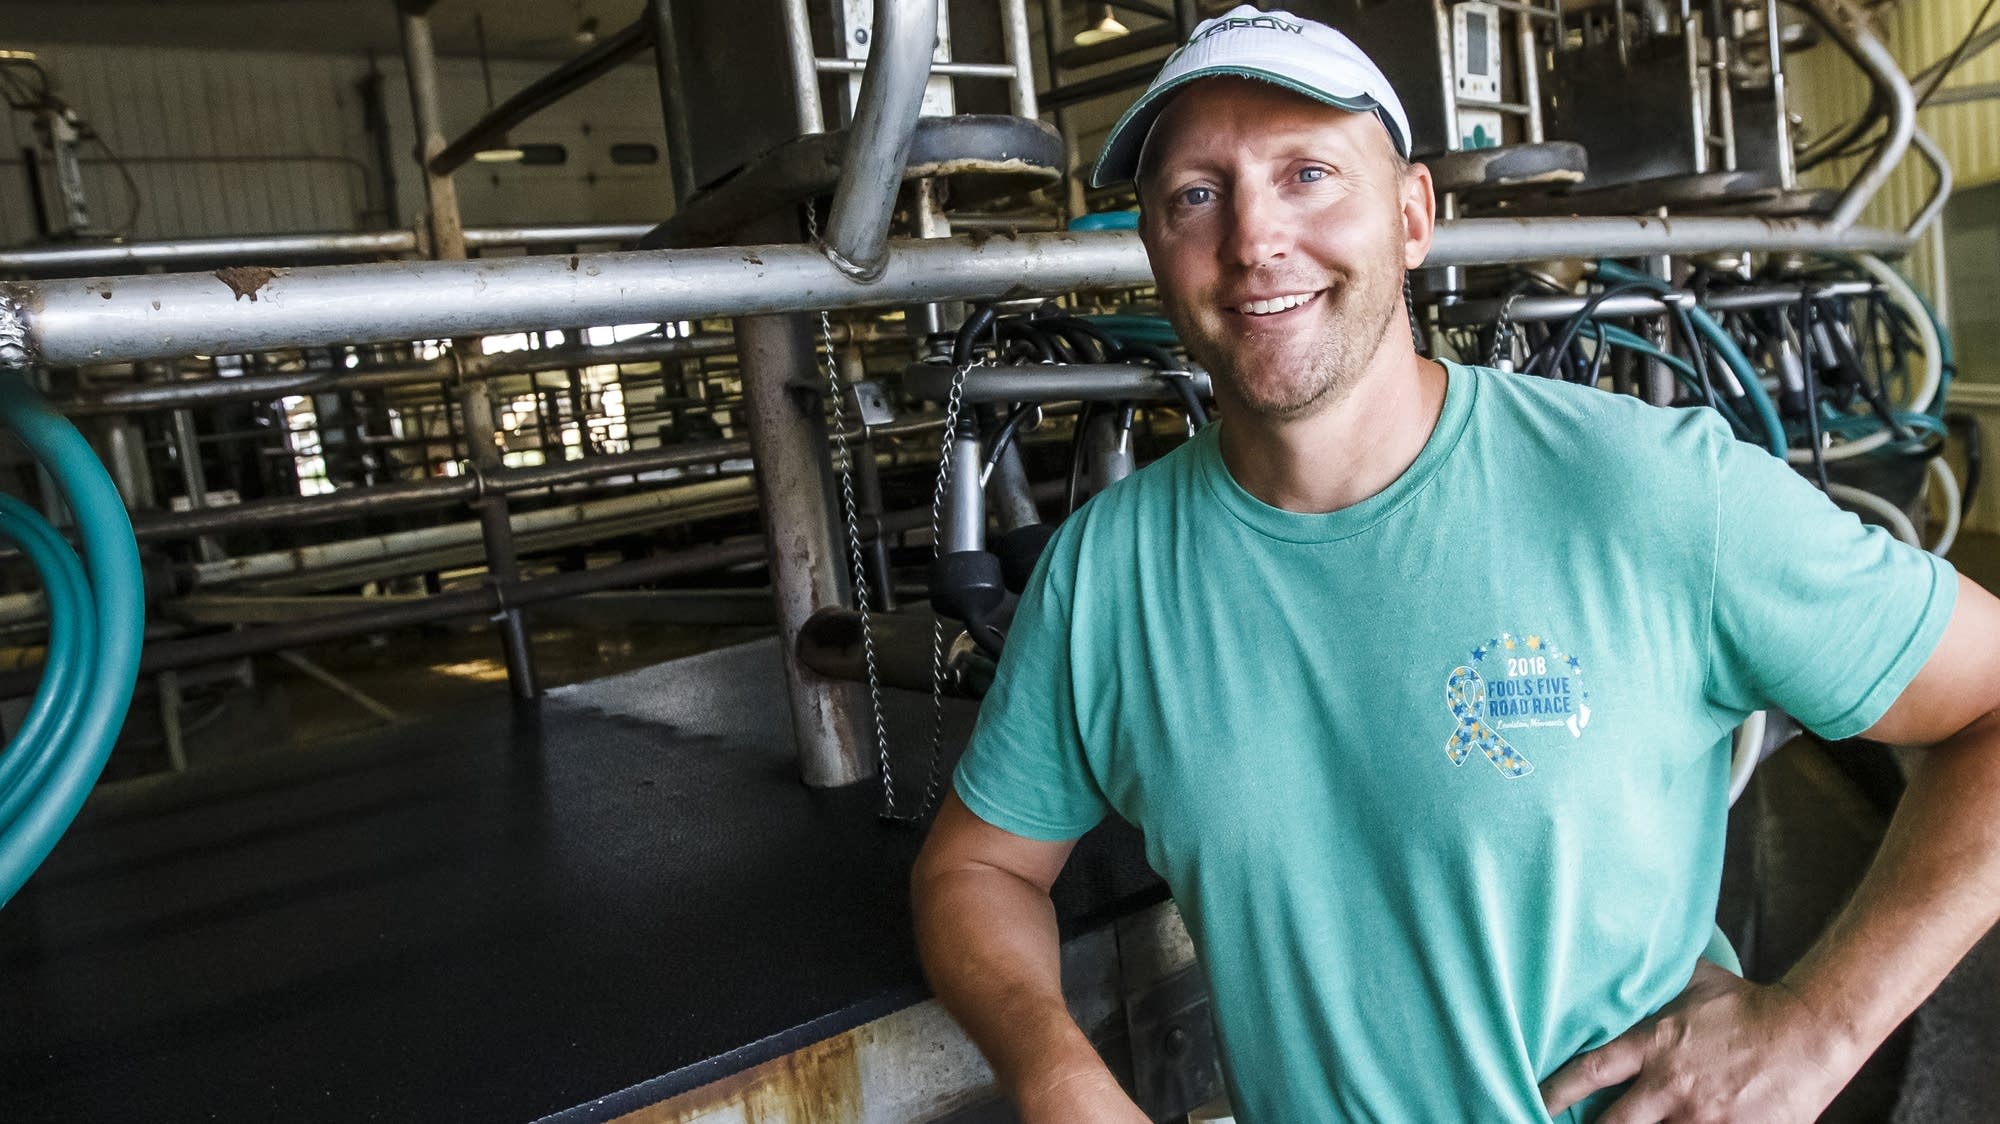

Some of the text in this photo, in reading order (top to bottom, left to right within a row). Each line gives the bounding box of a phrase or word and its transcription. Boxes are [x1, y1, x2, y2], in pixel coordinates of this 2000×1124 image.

[1508, 656, 1547, 677] 2018
[1488, 677, 1571, 698] FOOLS FIVE
[1489, 697, 1572, 717] ROAD RACE
